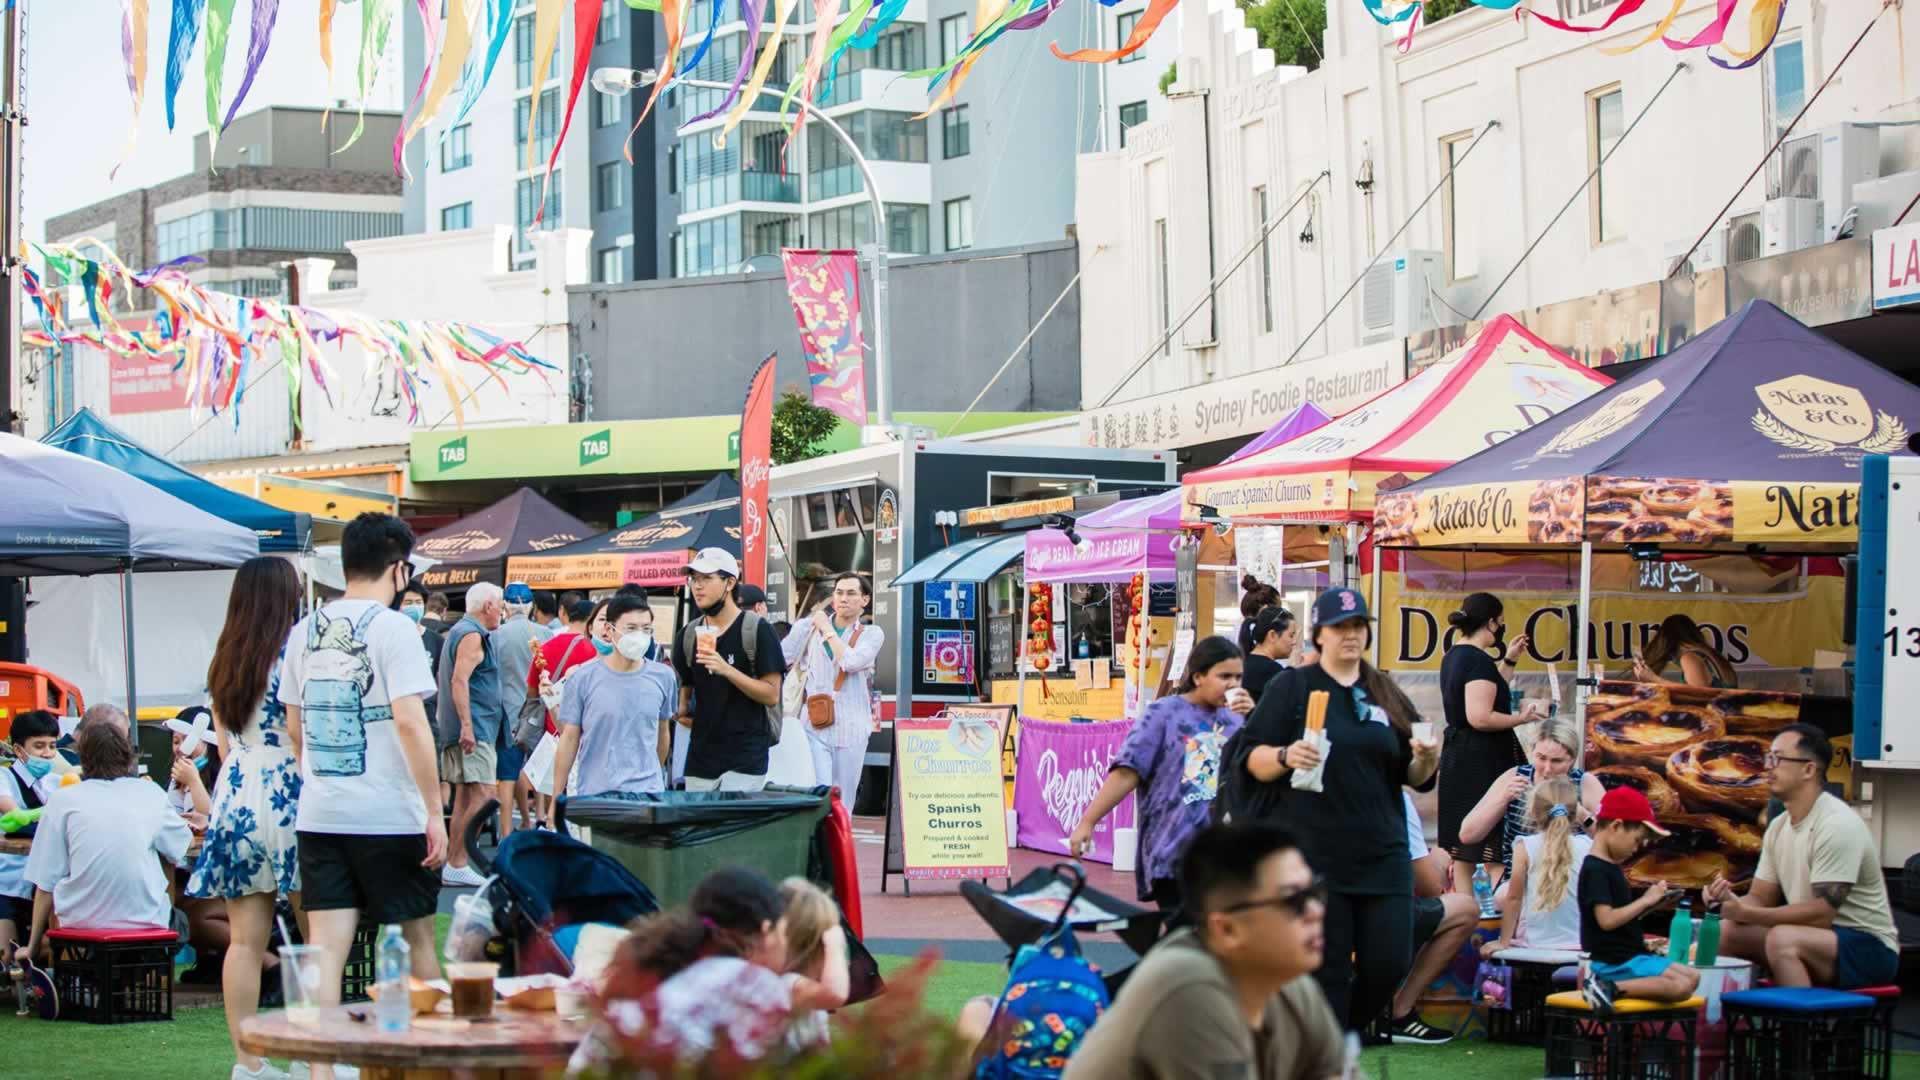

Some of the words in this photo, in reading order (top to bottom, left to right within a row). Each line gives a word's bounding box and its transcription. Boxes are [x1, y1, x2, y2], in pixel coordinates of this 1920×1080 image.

[1195, 396, 1247, 434] Sydney
[1251, 381, 1299, 417] Foodie
[1305, 360, 1389, 402] Restaurant
[1769, 389, 1849, 407] Natas
[1804, 408, 1867, 427] &Co.
[440, 446, 466, 463] TAB
[581, 440, 608, 456] TAB
[743, 455, 769, 488] Coffee
[1205, 486, 1240, 507] Gourmet
[1241, 479, 1273, 510] Spanish
[1275, 478, 1311, 502] Churros
[1424, 487, 1517, 536] Natas&Co.
[1764, 485, 1862, 532] Nat
[16, 531, 41, 545] born
[47, 530, 56, 545] to
[60, 535, 101, 548] explore
[1053, 545, 1071, 563] REAL
[1095, 540, 1110, 559] ICE
[1111, 537, 1140, 558] CREAM
[420, 571, 448, 585] PORK
[448, 568, 479, 584] BELLY
[565, 571, 596, 581] GOURMET
[597, 570, 619, 580] PLATES
[628, 568, 659, 580] PULLED
[1524, 603, 1751, 664] Churos
[1049, 687, 1088, 705] Sensation
[914, 755, 993, 774] Churros
[908, 792, 919, 800] Try
[967, 791, 999, 799] authentic
[927, 803, 982, 816] Spanish
[928, 818, 983, 829] Churros
[923, 834, 955, 844] Prepared
